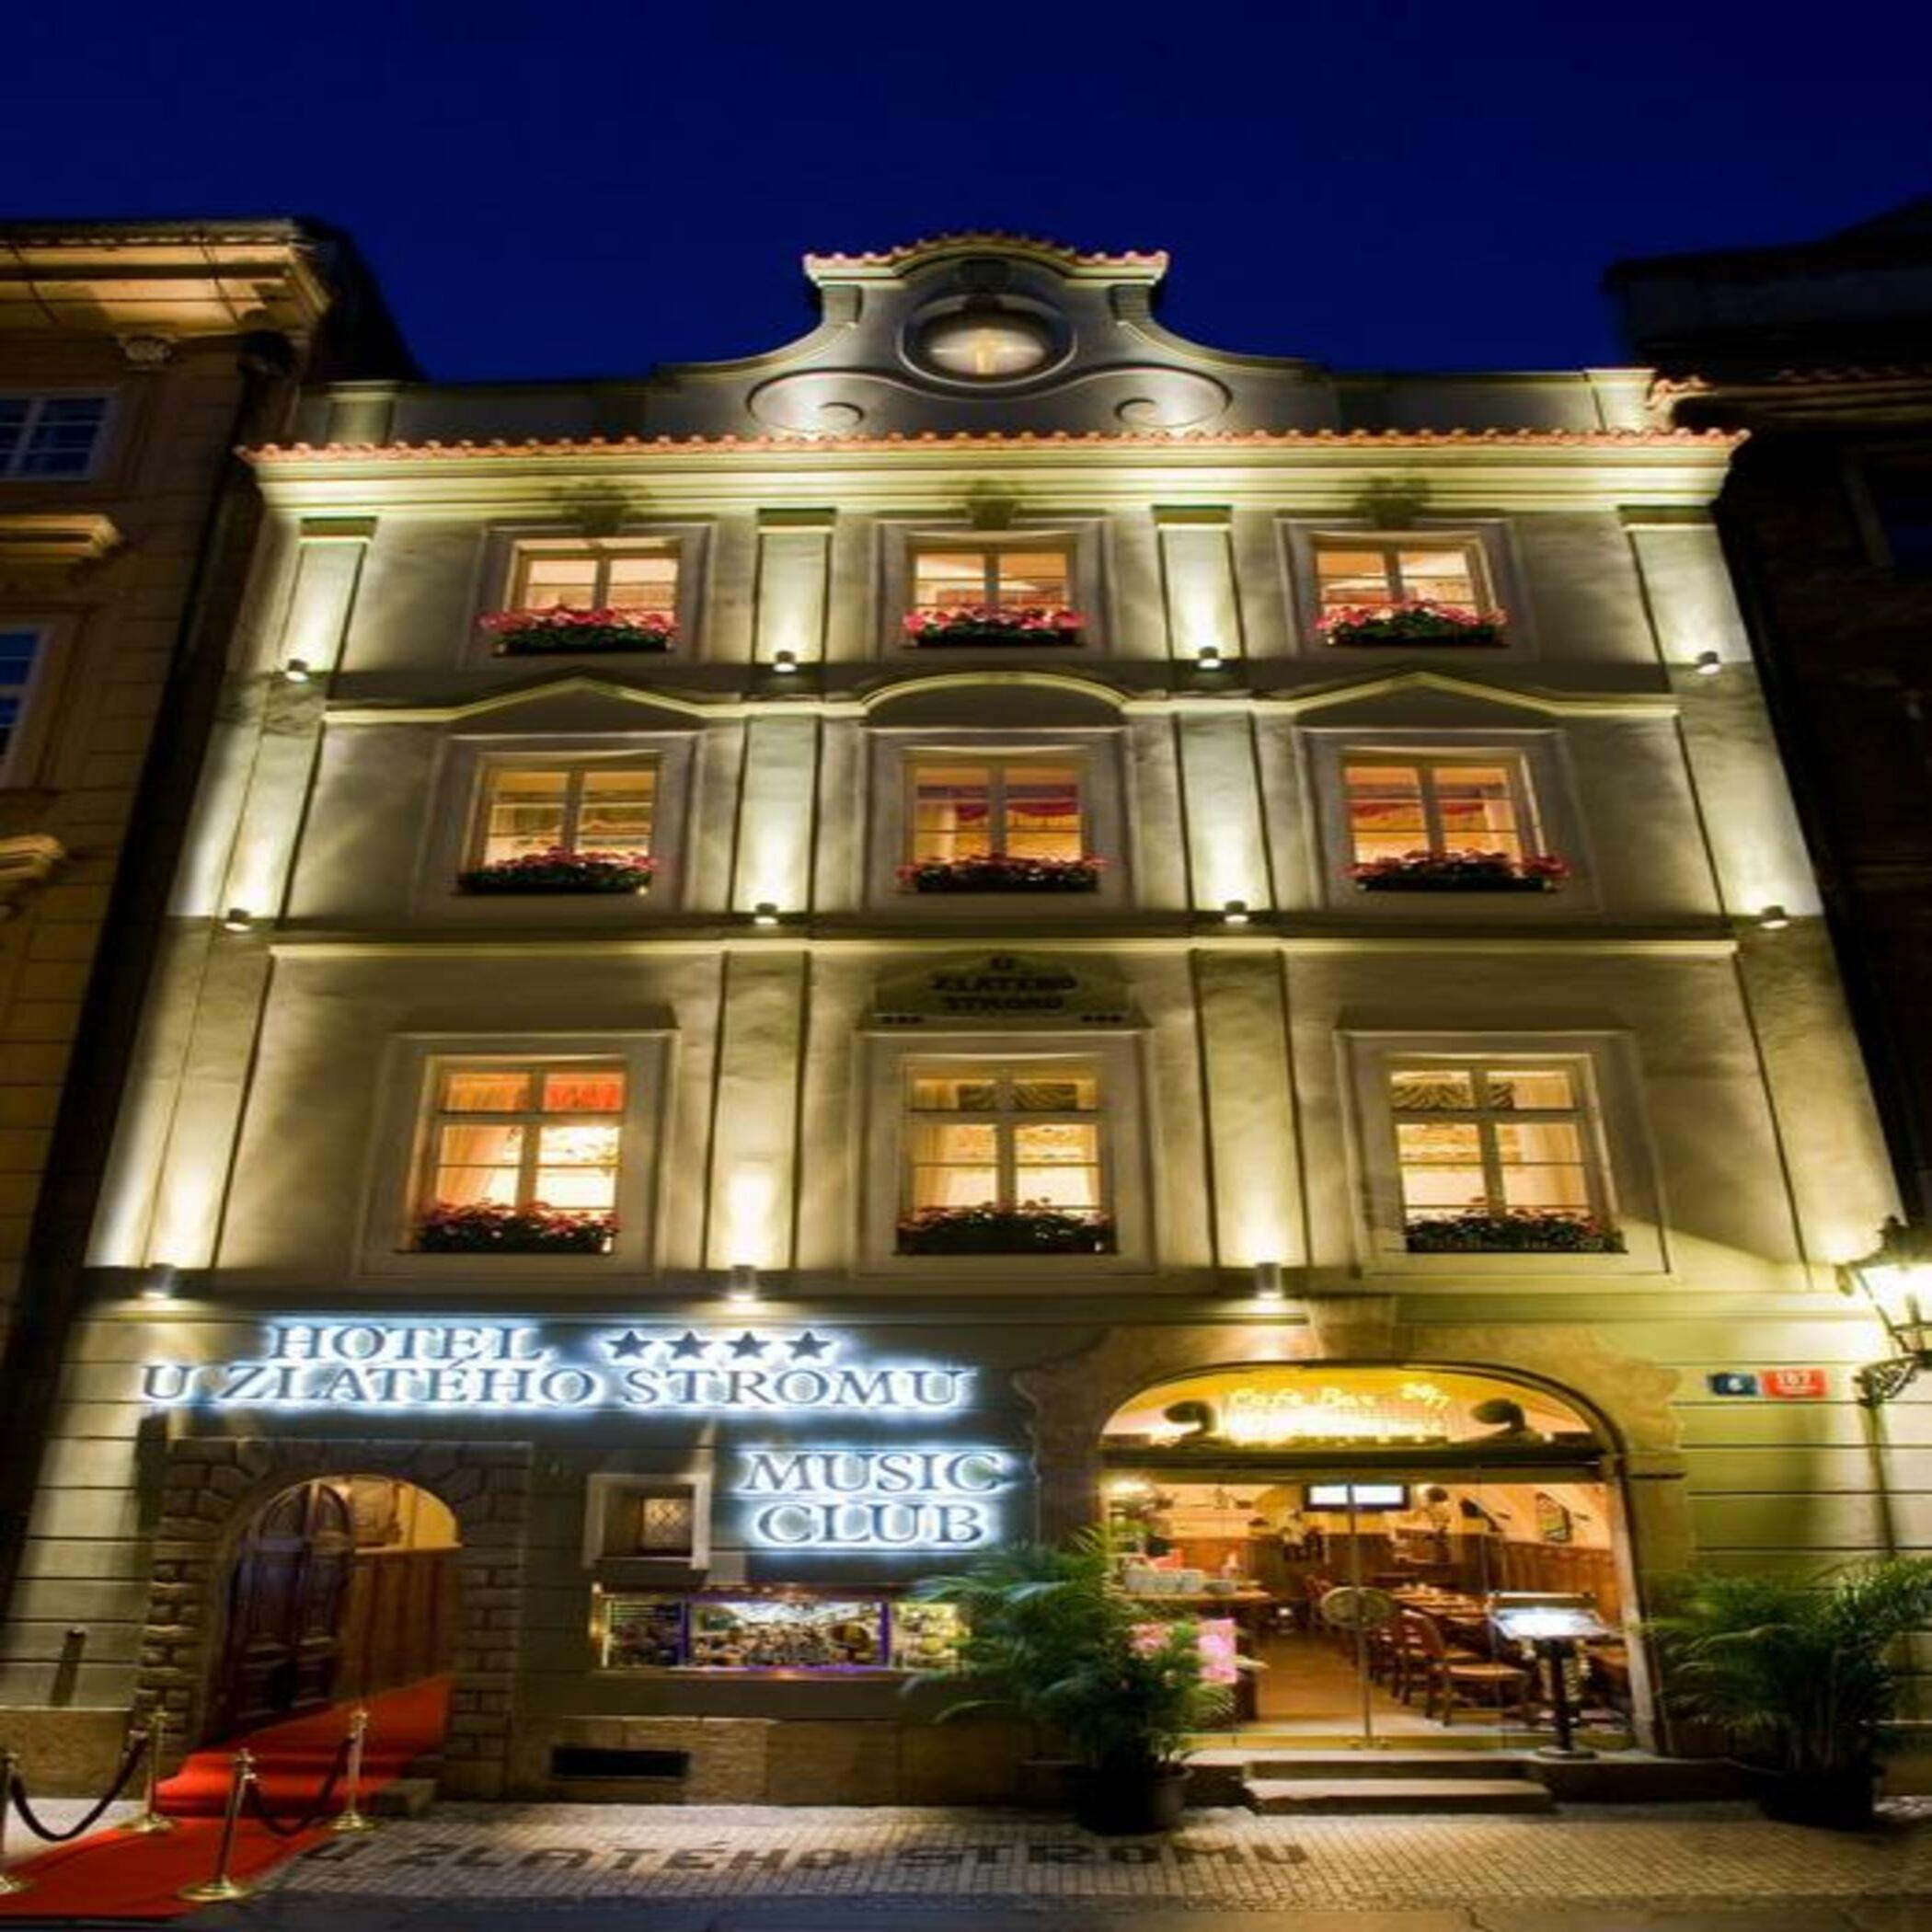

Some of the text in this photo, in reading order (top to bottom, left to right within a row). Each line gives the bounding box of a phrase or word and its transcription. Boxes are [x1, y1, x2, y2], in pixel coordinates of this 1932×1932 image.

[270, 1325, 549, 1360] HOTEL
[142, 1357, 968, 1406] U ZLATÉHO STROMU
[742, 1452, 1008, 1492] MUSIC
[757, 1503, 983, 1544] CLUB
